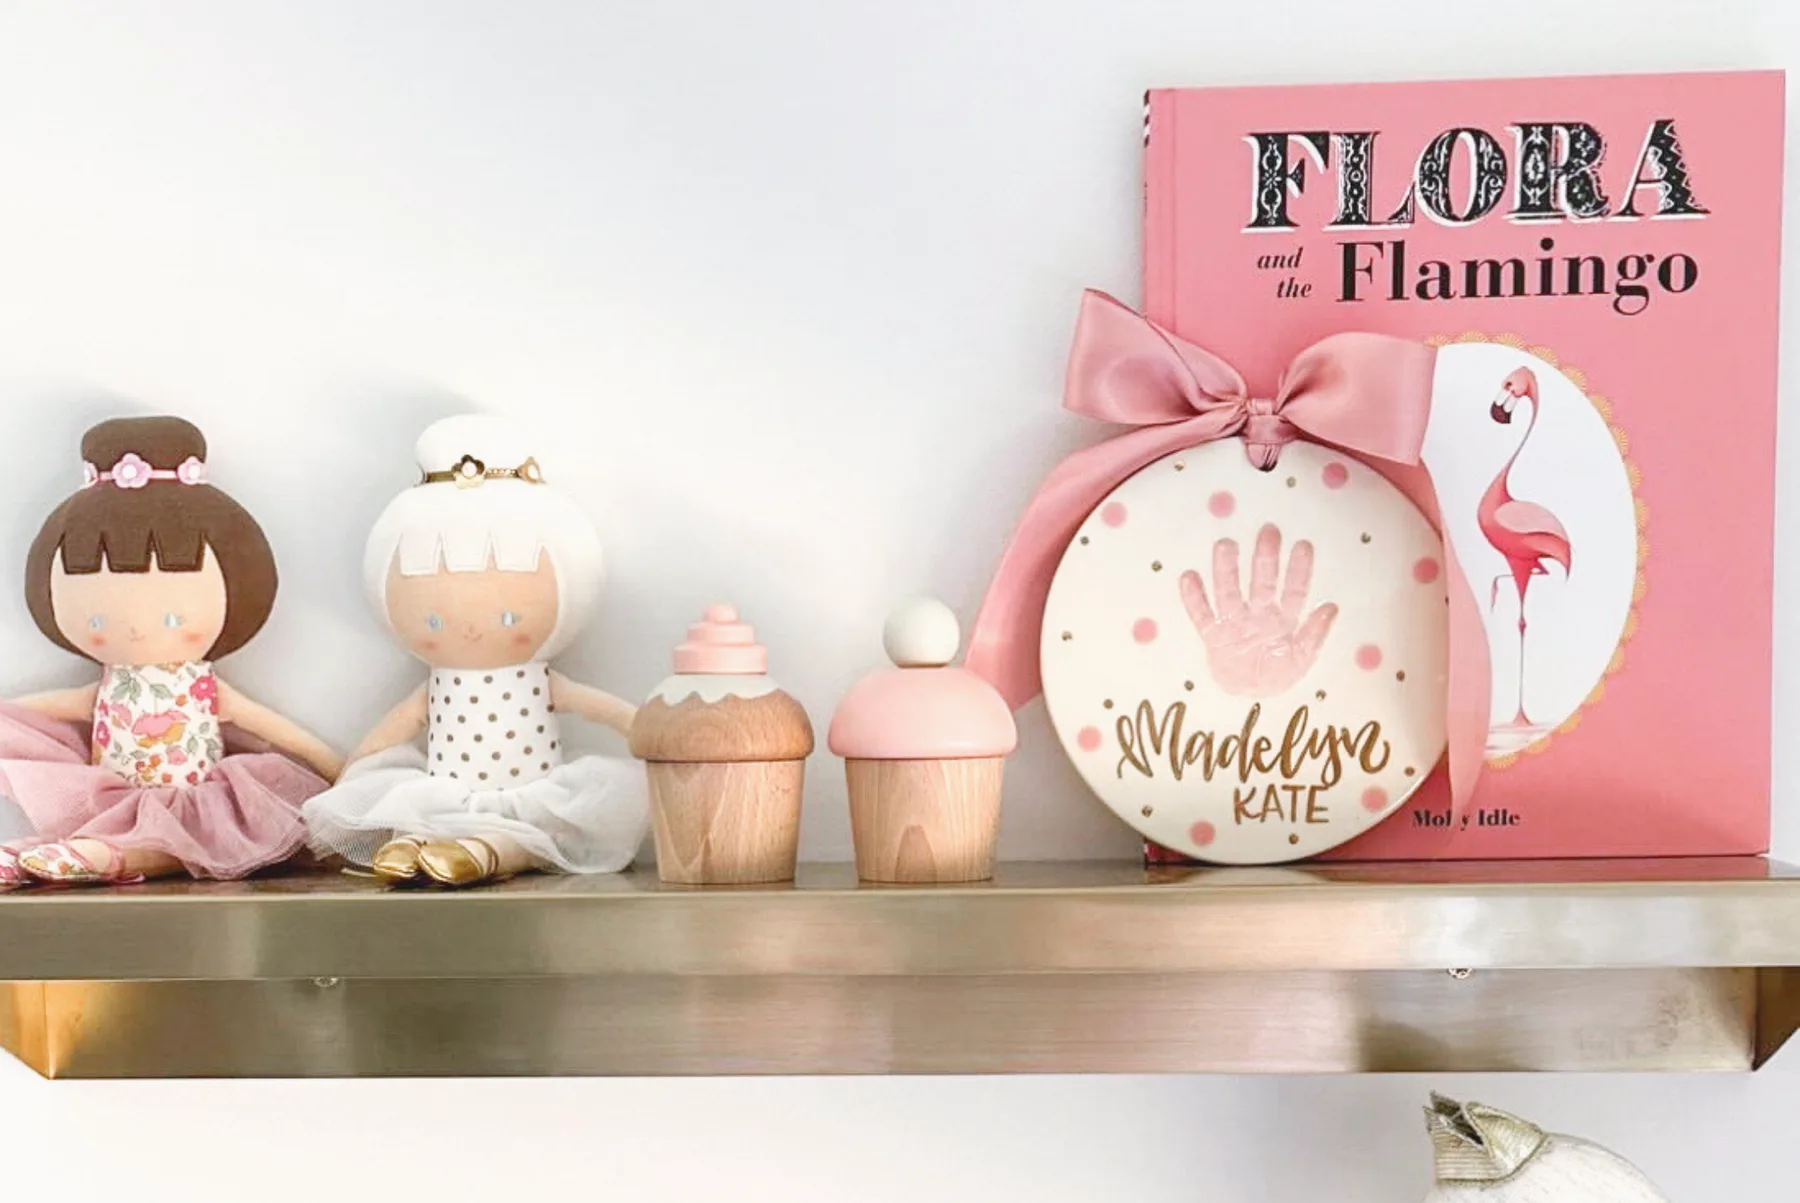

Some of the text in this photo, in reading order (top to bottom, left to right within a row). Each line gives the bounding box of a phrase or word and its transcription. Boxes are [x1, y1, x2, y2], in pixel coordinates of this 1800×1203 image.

[1240, 119, 1711, 233] FLORA
[1257, 246, 1303, 270] and
[1336, 238, 1699, 316] Flamingo
[1277, 277, 1312, 299] the
[1116, 699, 1390, 787] Madelyn
[1233, 784, 1330, 825] KATE
[1412, 809, 1520, 831] Moly Idle
